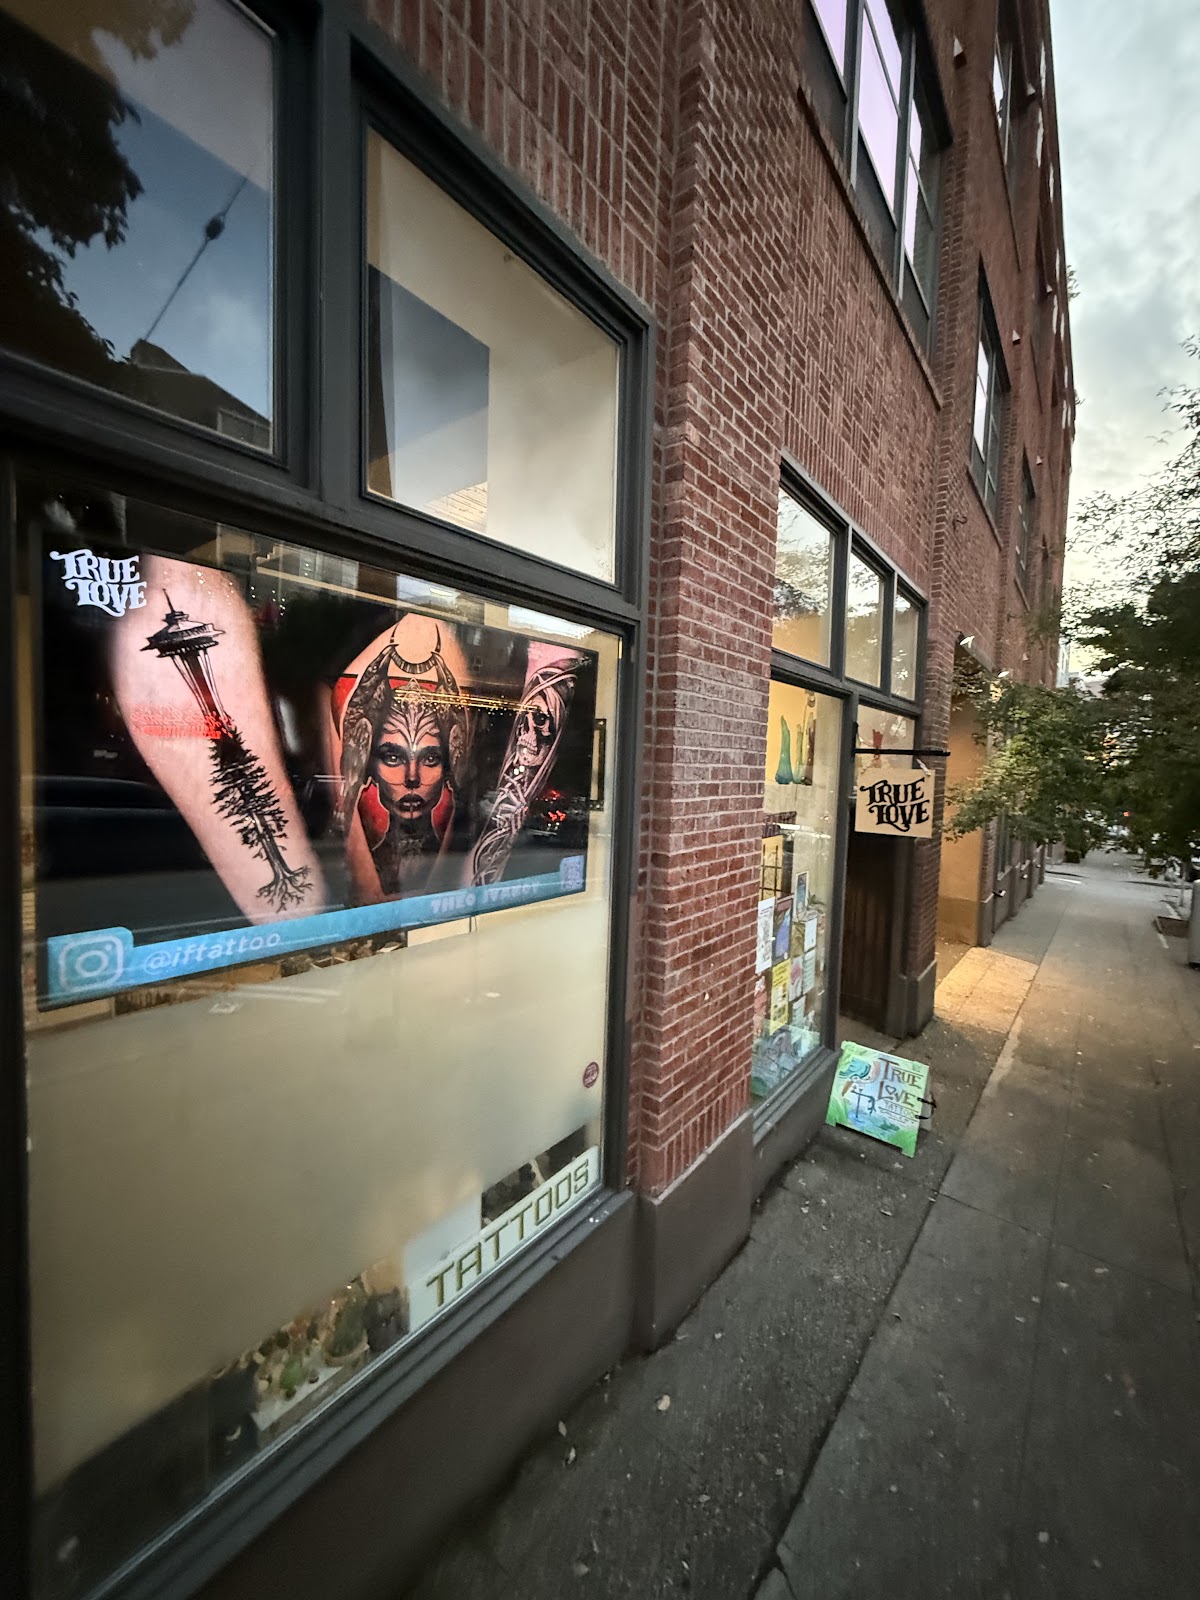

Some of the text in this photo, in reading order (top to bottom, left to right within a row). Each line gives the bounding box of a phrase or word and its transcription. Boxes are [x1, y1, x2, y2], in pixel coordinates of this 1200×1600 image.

[49, 549, 140, 582] TRUE
[65, 579, 148, 617] LOVE
[859, 777, 925, 806] TRUE
[868, 800, 930, 832] LOVE
[144, 932, 281, 975] @iftattoo
[877, 1058, 922, 1089] TRUE
[426, 1159, 589, 1307] TATTOOS
